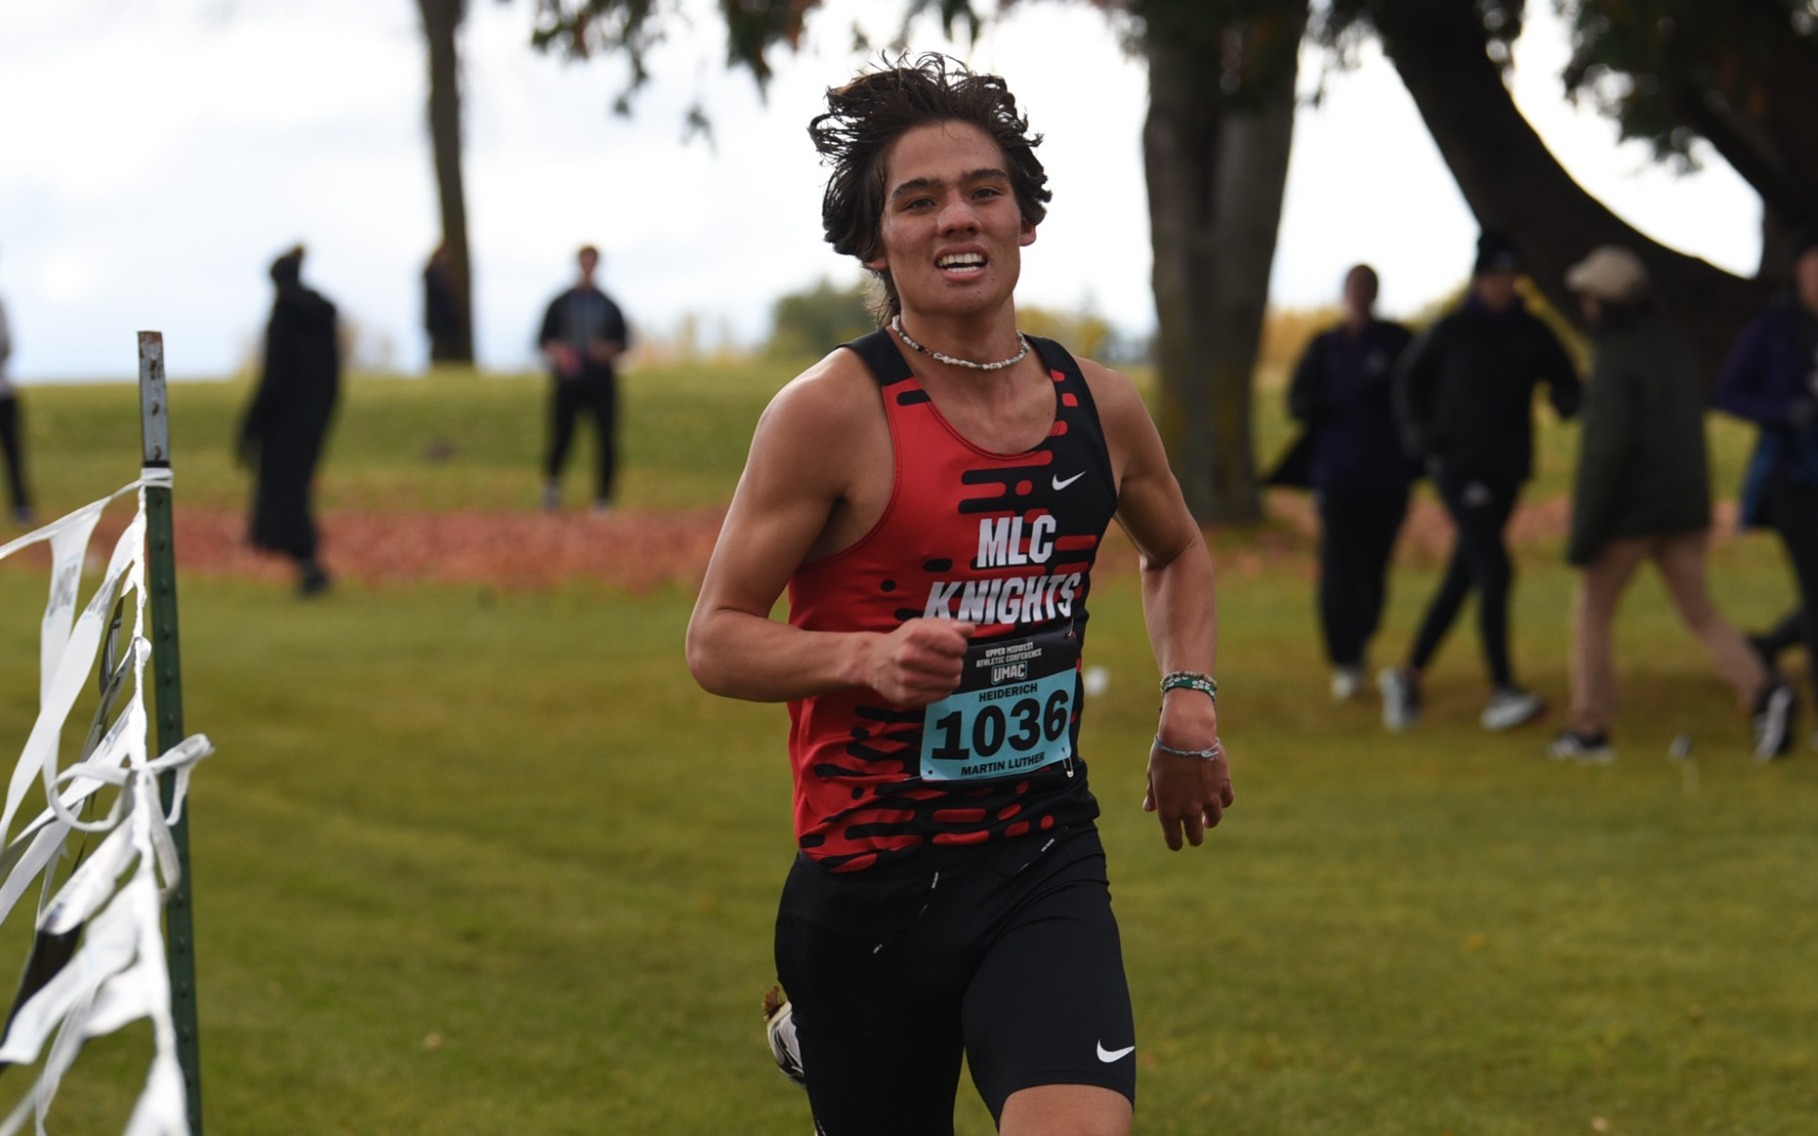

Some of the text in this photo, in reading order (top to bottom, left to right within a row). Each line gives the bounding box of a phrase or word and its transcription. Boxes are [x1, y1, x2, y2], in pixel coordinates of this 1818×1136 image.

[977, 515, 1056, 568] MLC
[922, 572, 1081, 624] KNIGHTS
[976, 648, 1042, 667] ATHLETIC CONFERENCE
[985, 642, 1033, 657] UPPER MIDWEST
[993, 663, 1025, 682] UMAC
[979, 683, 1037, 702] HEIDERICH
[932, 689, 1069, 760] 1036
[961, 751, 1045, 776] MARTIN LUTHER
